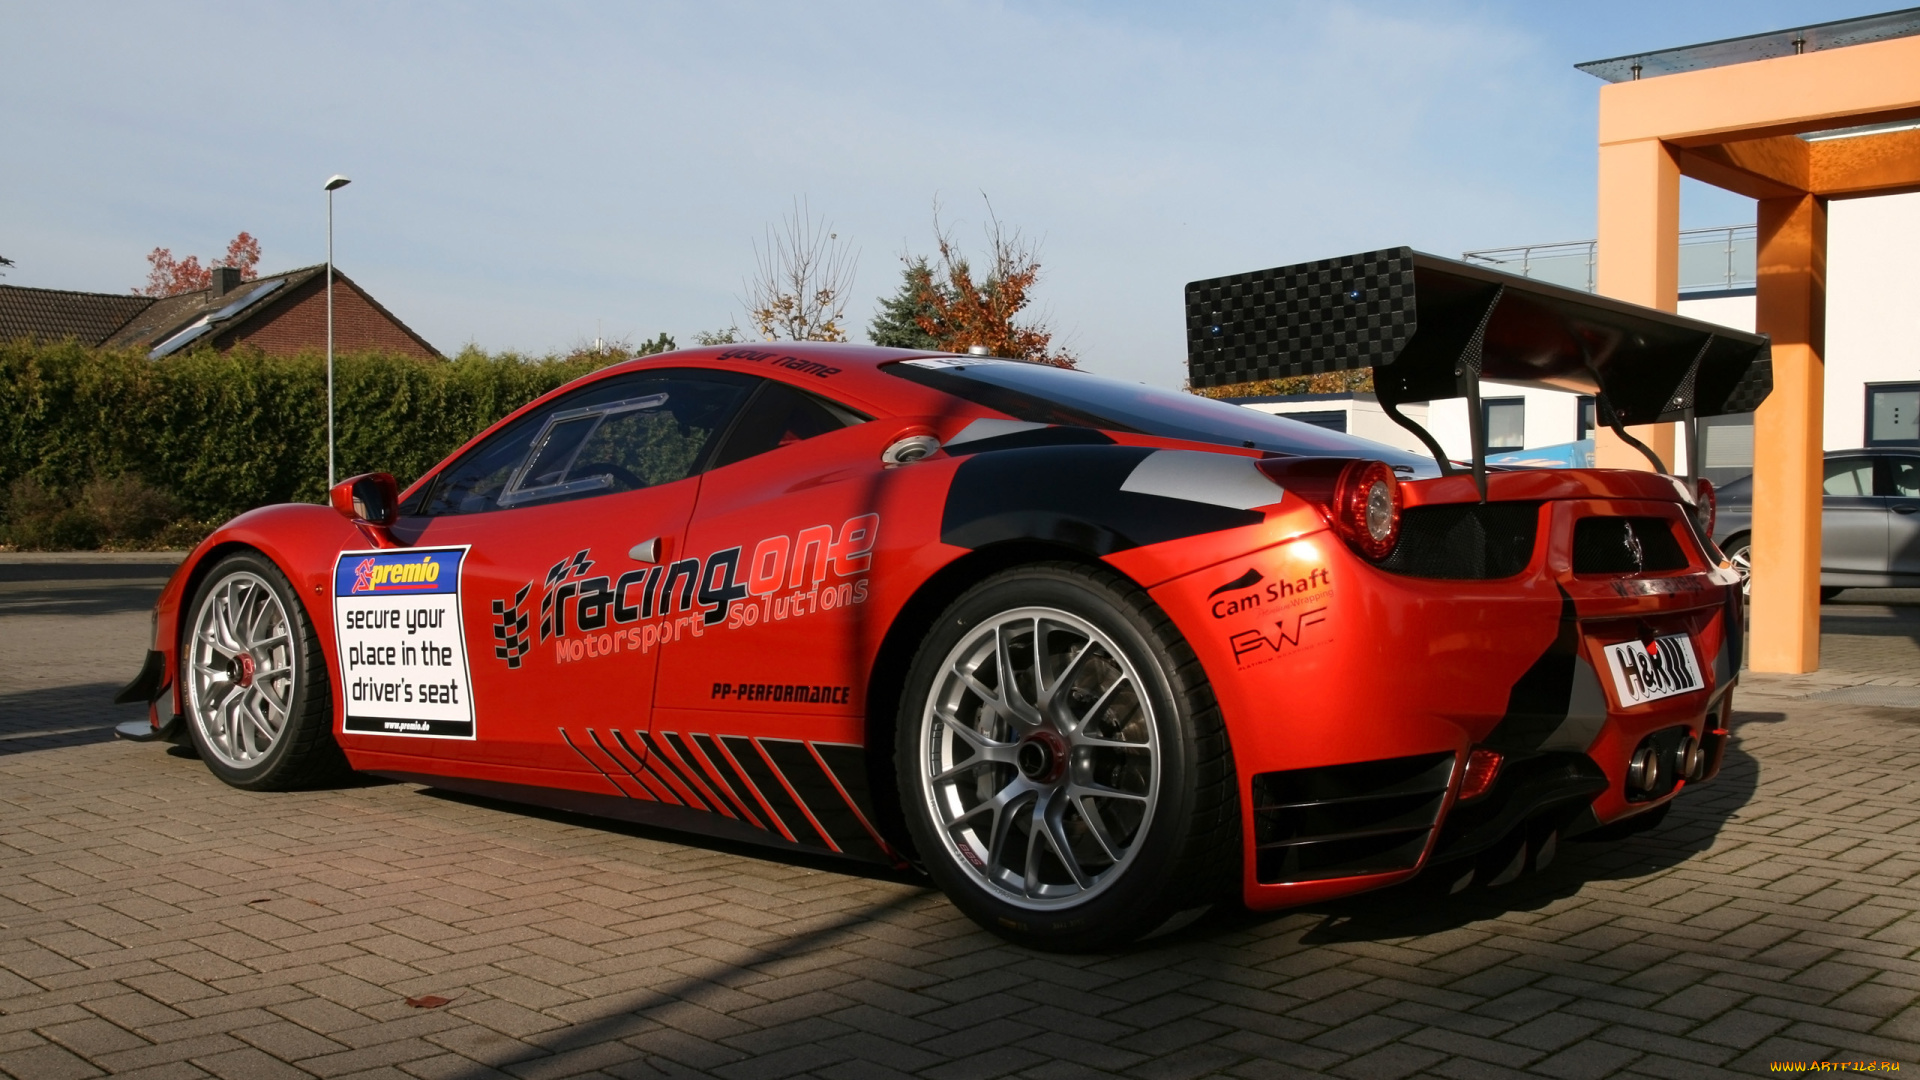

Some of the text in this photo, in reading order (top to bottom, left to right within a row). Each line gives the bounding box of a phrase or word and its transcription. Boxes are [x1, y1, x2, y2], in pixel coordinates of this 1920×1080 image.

[717, 349, 842, 378] your name
[368, 556, 439, 591] premio
[554, 512, 880, 637] racing one
[1211, 567, 1330, 619] Cam Shaft
[346, 608, 445, 635] secure your
[555, 611, 704, 664] Motorsport
[350, 641, 452, 671] place in the
[352, 677, 459, 704] driver's seat
[711, 683, 850, 704] PP-PERFORMANCE
[958, 843, 982, 867] BBS
